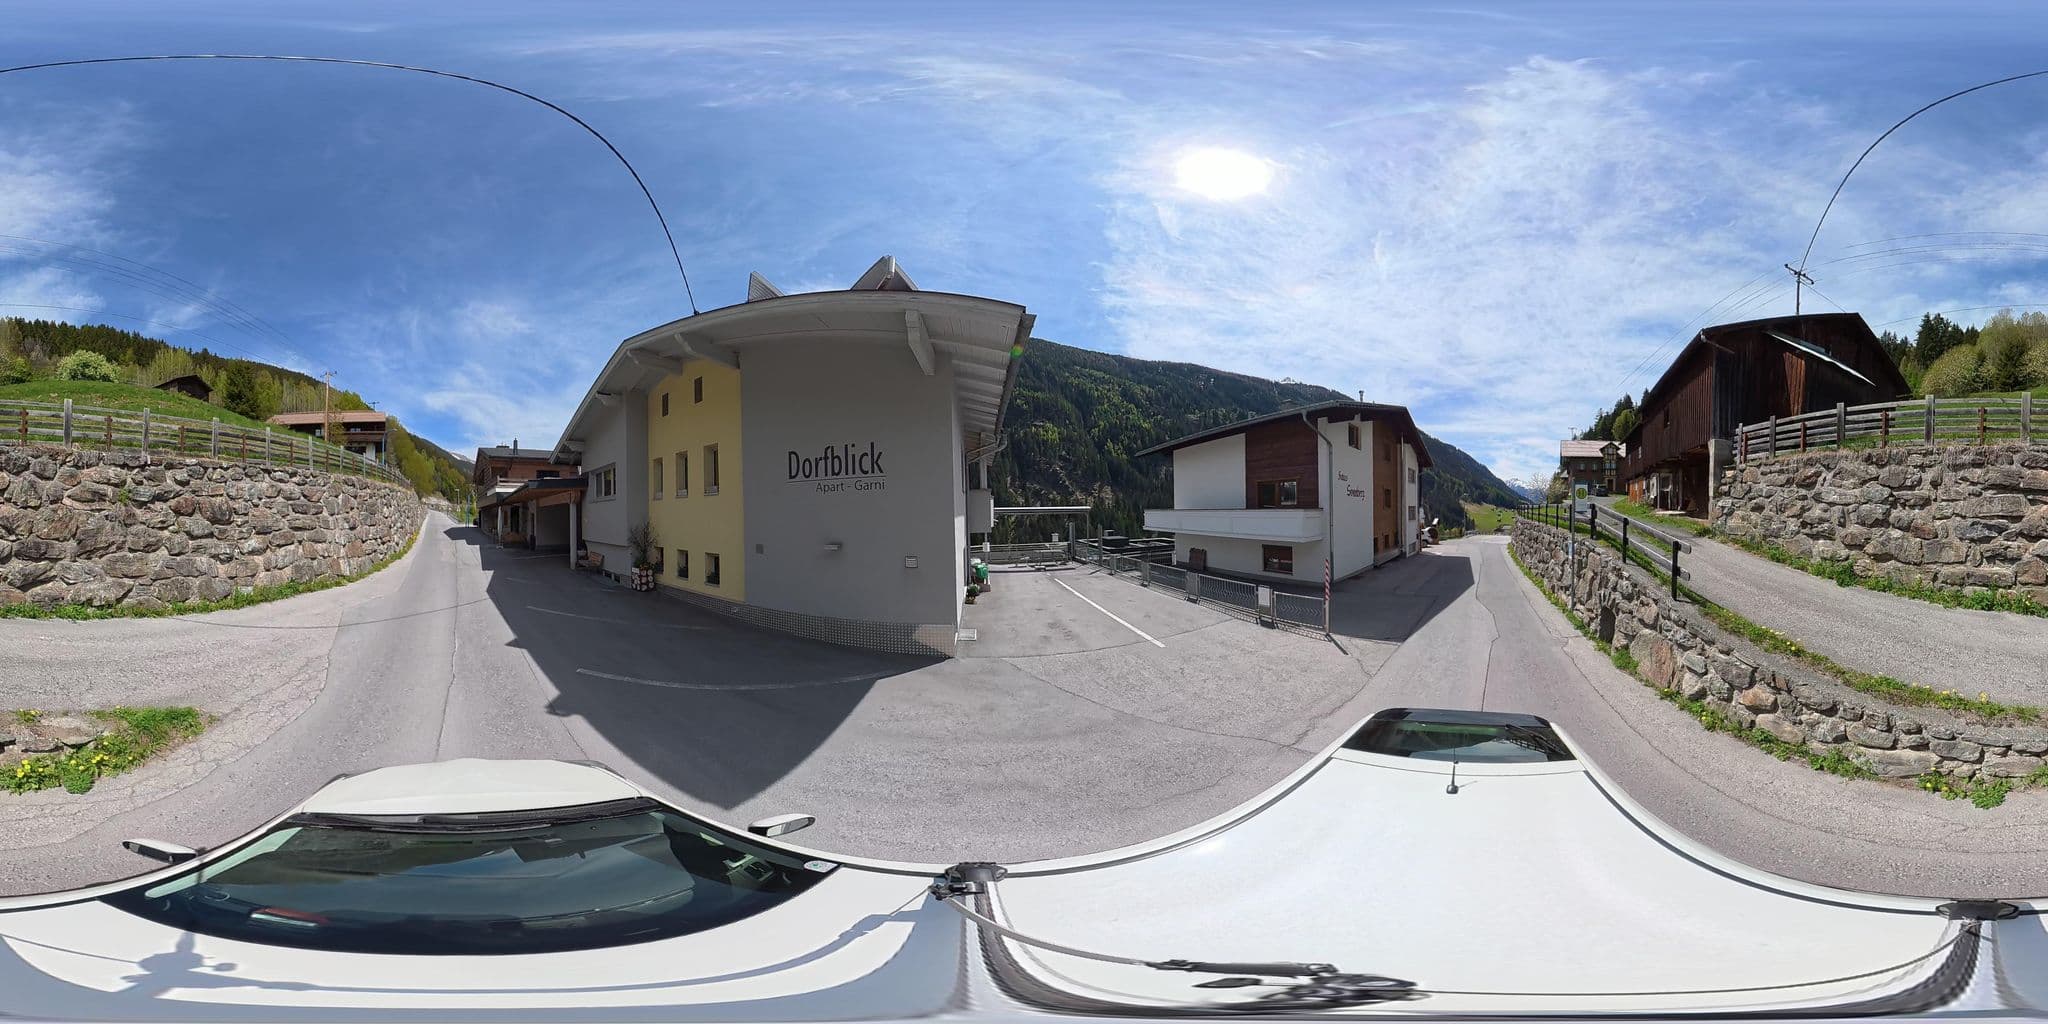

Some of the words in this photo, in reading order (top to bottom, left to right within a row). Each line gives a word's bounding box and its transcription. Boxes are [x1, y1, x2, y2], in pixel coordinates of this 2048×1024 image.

[788, 441, 884, 480] Dorfblick
[815, 482, 845, 495] Apart
[854, 479, 885, 491] Garni
